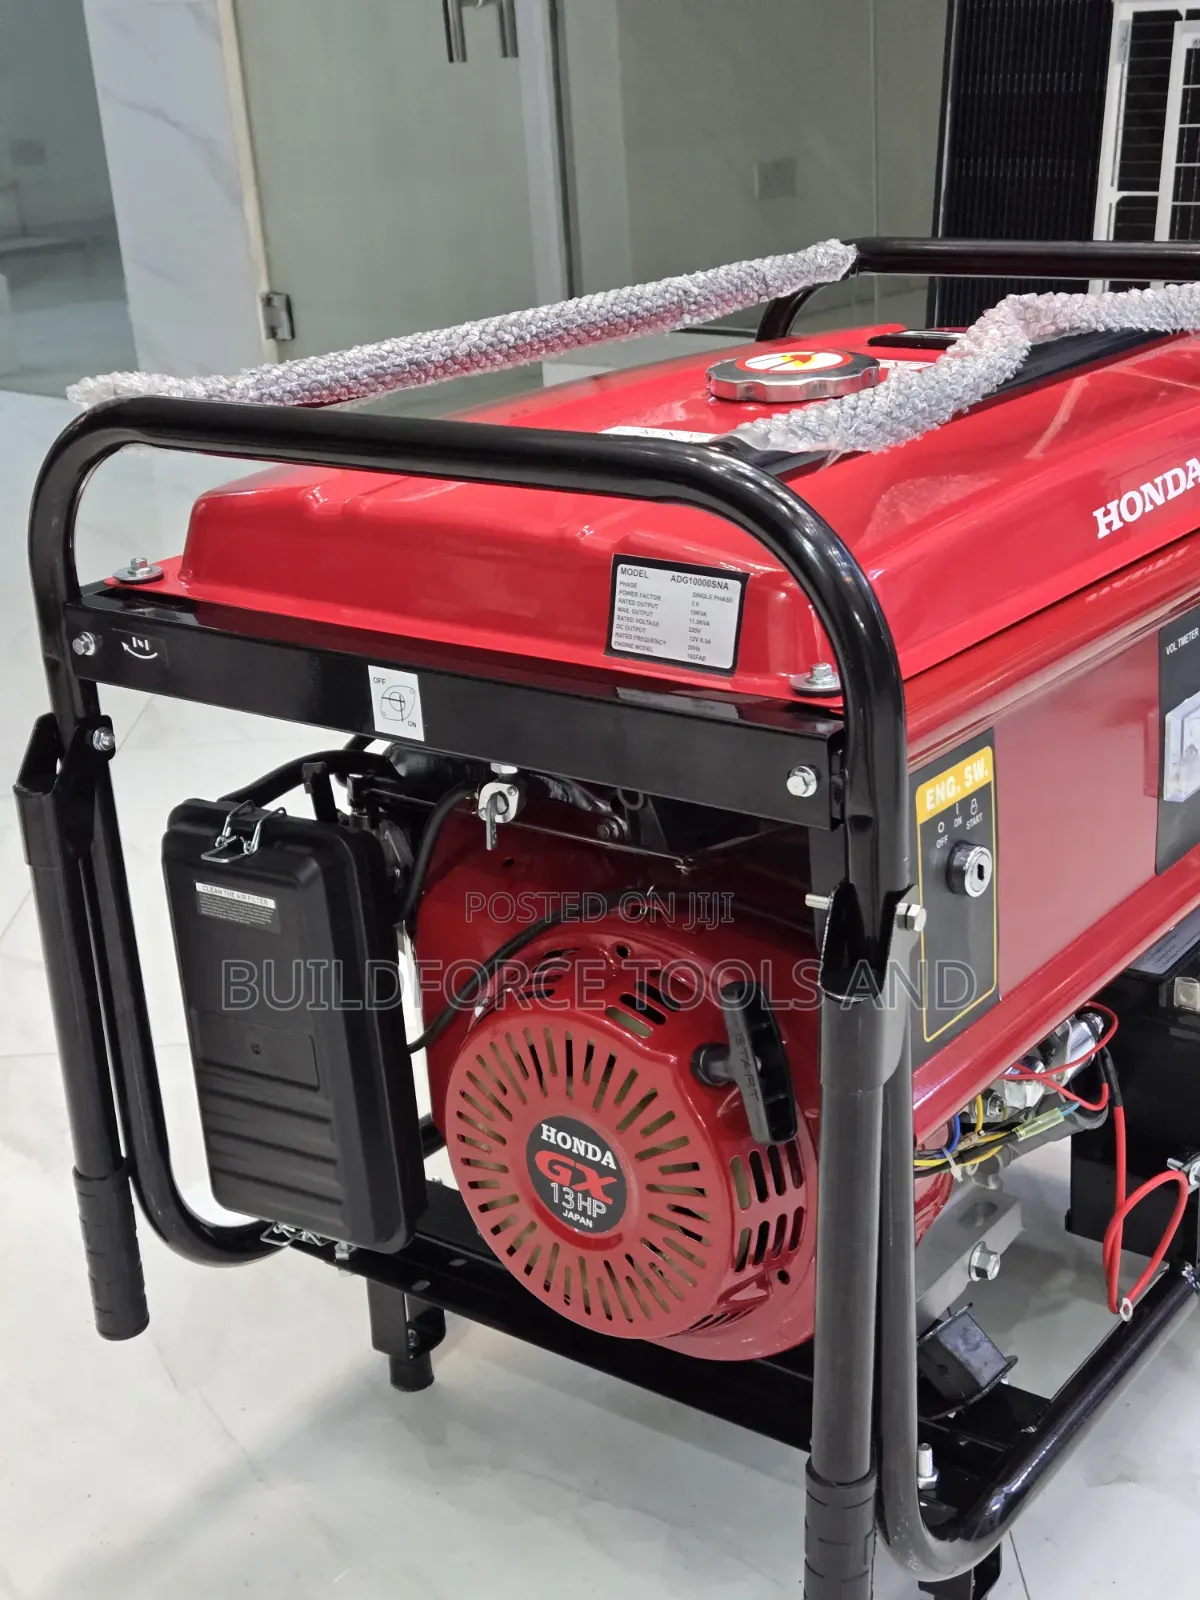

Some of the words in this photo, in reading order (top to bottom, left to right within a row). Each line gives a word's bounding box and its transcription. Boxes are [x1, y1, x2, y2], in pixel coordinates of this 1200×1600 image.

[1092, 457, 1200, 539] HONDA
[620, 567, 649, 579] MODEL
[670, 575, 729, 590] ADG10000SNA
[618, 590, 638, 598] POWER
[639, 593, 661, 601] FACTOR
[692, 592, 713, 600] SINGLE
[714, 595, 734, 603] PHASE
[618, 598, 636, 606] RATED
[636, 601, 659, 609] OUTPUT
[631, 609, 653, 617] OUTPUT
[616, 615, 634, 623] RATED
[635, 618, 660, 627] VOLTAGE
[624, 625, 646, 633] OUTPUT
[615, 632, 632, 640] RATED
[633, 635, 667, 646] FREQUENCY
[614, 641, 634, 649] ENGINE
[634, 644, 654, 653] MODEL
[373, 676, 386, 685] OFF
[407, 720, 417, 728] ON
[926, 775, 961, 811] ENG.
[963, 757, 989, 788] SW.
[953, 816, 962, 828] ON
[965, 813, 983, 830] START
[936, 835, 948, 848] OFF
[202, 885, 222, 895] CLEAN
[224, 890, 235, 899] THE
[247, 896, 269, 906] FILTER
[540, 1123, 617, 1170] HONDA
[534, 1150, 618, 1206] GX
[550, 1182, 607, 1218] 13HP
[562, 1209, 594, 1229] JAPAN
